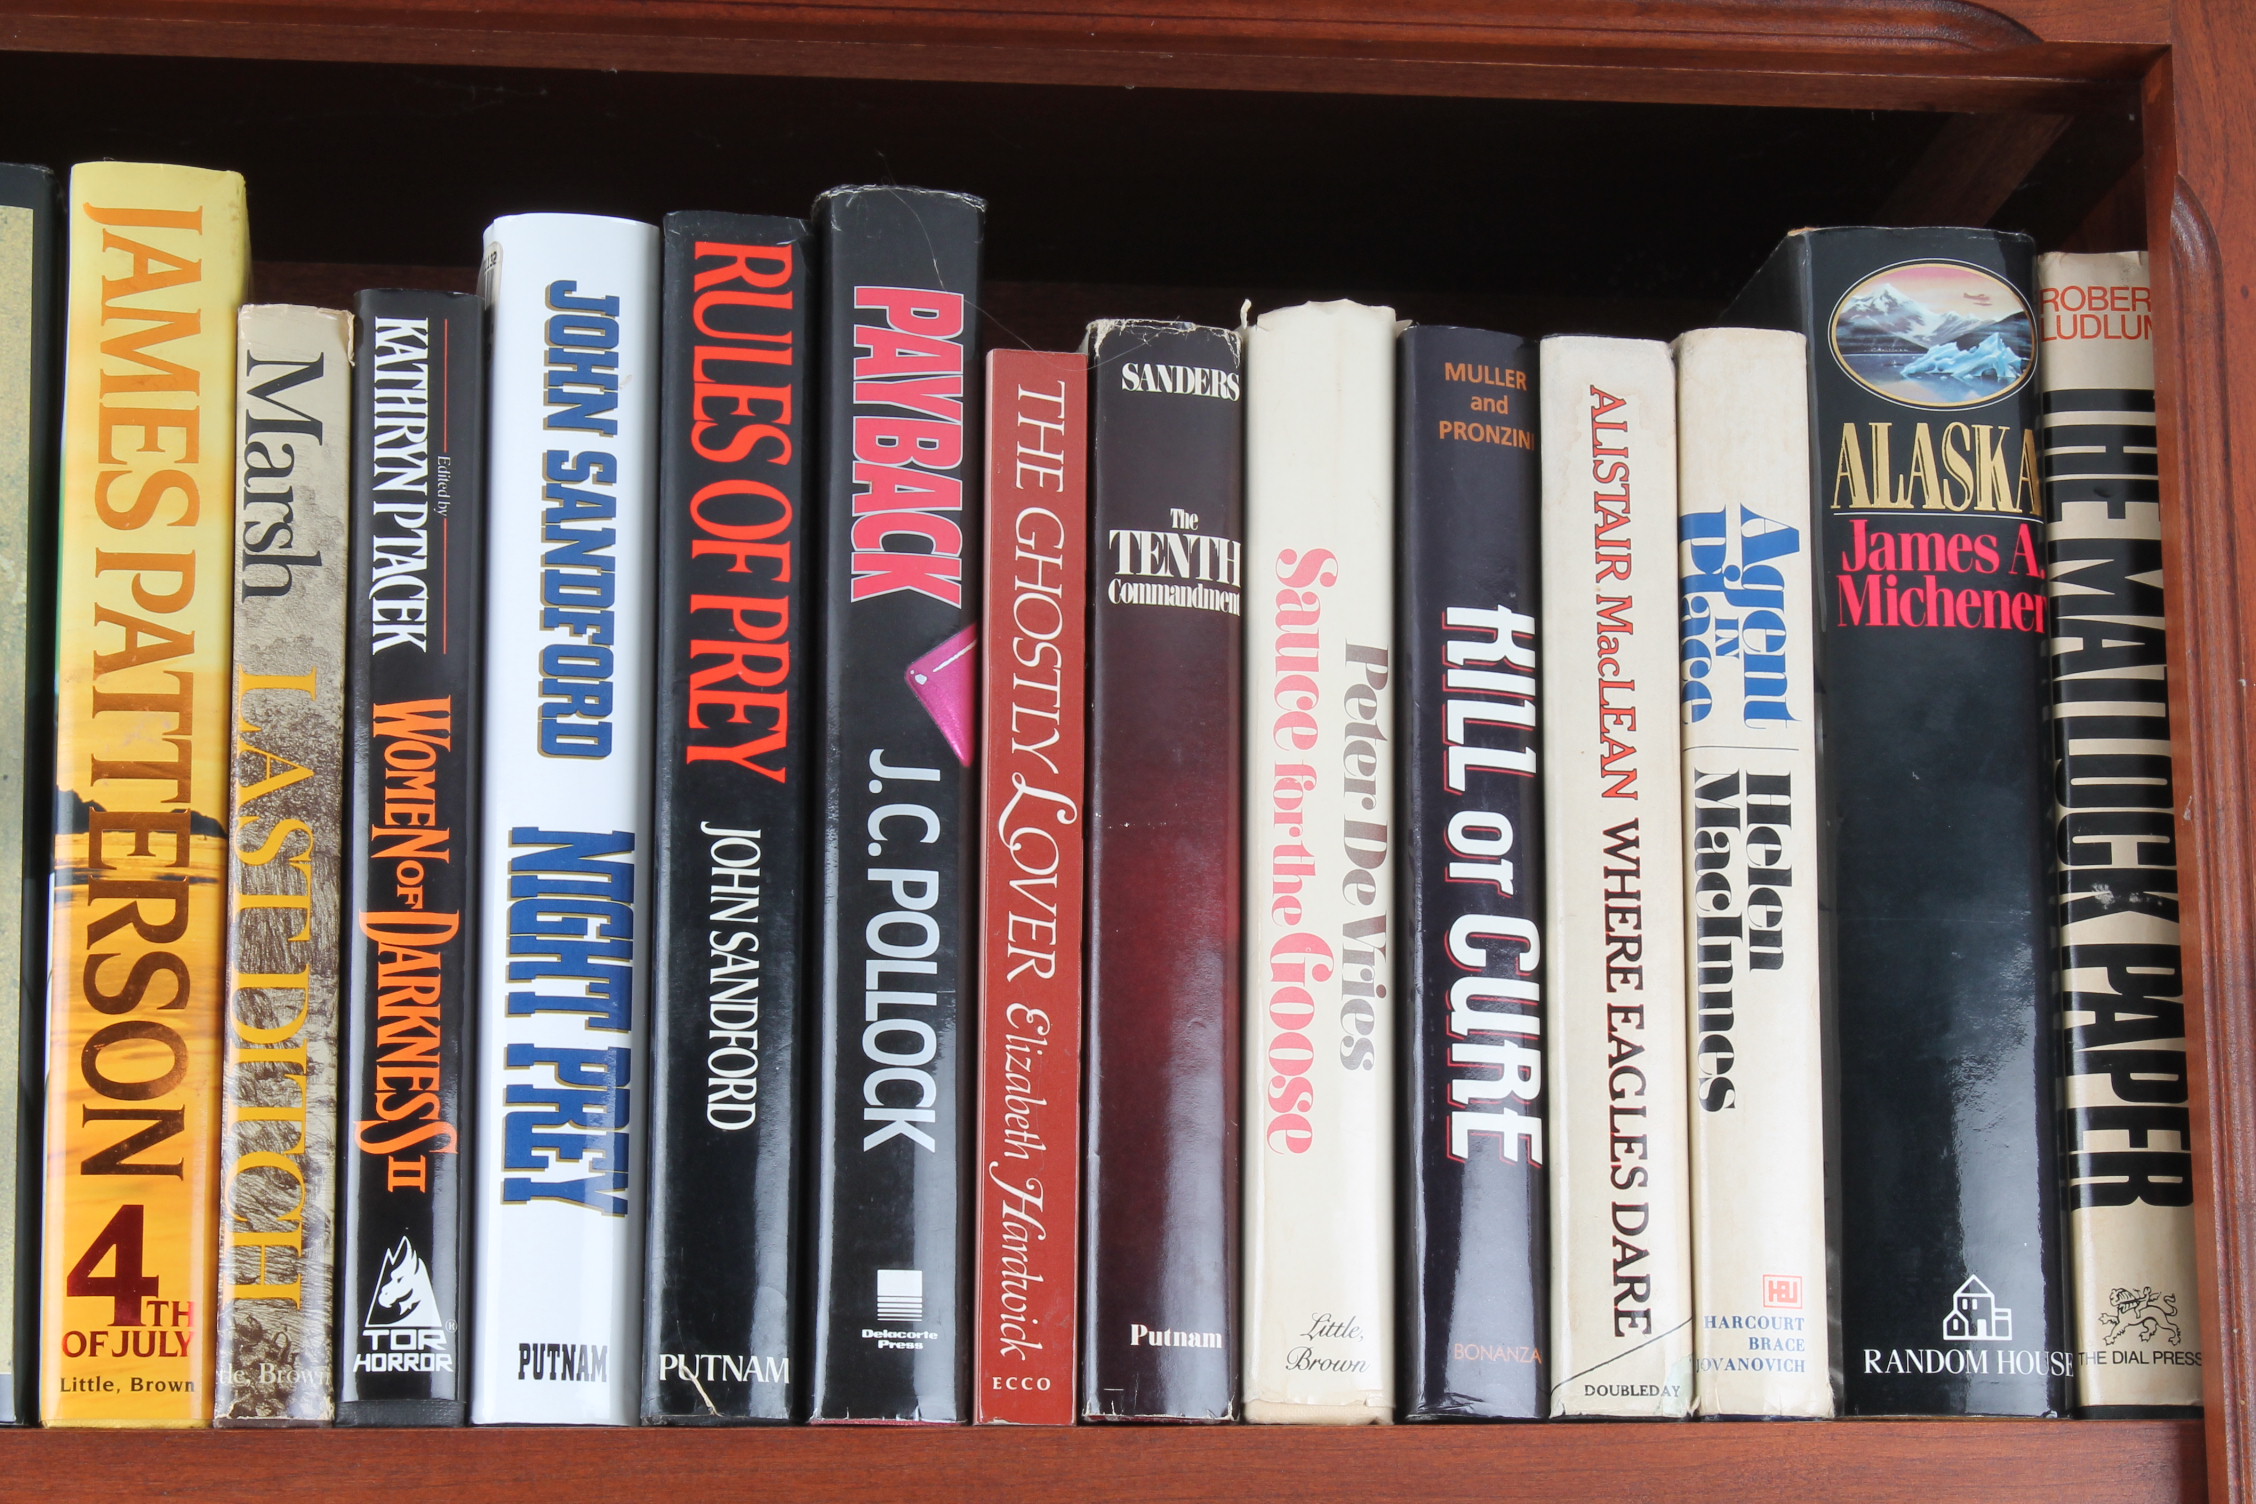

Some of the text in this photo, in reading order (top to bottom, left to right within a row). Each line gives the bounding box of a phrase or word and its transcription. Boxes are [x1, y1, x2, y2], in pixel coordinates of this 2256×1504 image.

[2040, 285, 2151, 313] ROBER
[1122, 362, 1240, 401] SANDERS
[1445, 362, 1527, 391] MULLER
[1471, 395, 1508, 414] and
[850, 285, 965, 610] PAYBACK
[1440, 421, 1534, 450] PRONZINI
[241, 350, 325, 602] Marsh
[370, 317, 429, 655] KATHRYN PTACEK
[436, 456, 451, 516] Edited by
[1831, 422, 2043, 516] ALASKA
[537, 280, 620, 760] JOHN SANDFORD
[686, 240, 794, 784] RULES OF PREY
[1170, 508, 1199, 530] The
[1109, 529, 1241, 588] TENTH
[1842, 519, 2046, 580] James A.
[1589, 384, 1638, 800] ALISTAIR MacLEAN
[1679, 503, 1727, 726] Place
[1722, 502, 1801, 729] Agent
[1836, 574, 2047, 633] Michener
[1715, 616, 1740, 660] IN
[80, 203, 203, 1182] JAMES PATTERSON
[998, 380, 1078, 983] THE GHOSTLY LOVER
[1266, 547, 1338, 1155] Sauce for the Goose
[1339, 639, 1389, 1072] Peter De Vries
[1744, 769, 1792, 973] Helen
[1442, 605, 1543, 1169] KILL or CURE
[354, 695, 460, 1193] WOMEN OF DARKNESS II
[1694, 768, 1743, 1113] MacInnes
[223, 665, 317, 1310] LAST DITCH
[700, 821, 761, 1131] JOHN SANDFORD
[500, 826, 635, 1218] NIGHT PREY
[861, 869, 941, 1154] POLLOCK
[1602, 818, 1653, 1338] WHERE EAGLES DARE
[2061, 944, 2193, 1213] PAPER
[989, 1002, 1050, 1361] Elizabeth Hardwick
[62, 1330, 195, 1358] OF JULY
[363, 1329, 447, 1350] TOR
[862, 1329, 938, 1340] Delacorte
[877, 1340, 923, 1350] Press
[1130, 1323, 1223, 1349] Putnam
[1300, 1313, 1364, 1341] Little,
[1704, 1315, 1804, 1331] HARCOURT
[1748, 1336, 1805, 1352] BRACE
[219, 1363, 251, 1386] tle,
[353, 1353, 453, 1372] HORROR
[518, 1343, 607, 1383] PUTNAM
[659, 1354, 790, 1384] PUTNAM
[992, 1376, 1050, 1390] ECCO
[1286, 1348, 1369, 1374] Brown
[1454, 1343, 1542, 1364] BONANZA
[1863, 1348, 2074, 1378] RANDOM HOUSE
[2079, 1351, 2202, 1367] THE DIAL PRESS
[60, 1376, 194, 1394] Little, Brown
[1584, 1384, 1681, 1399] DOUBLEDAY
